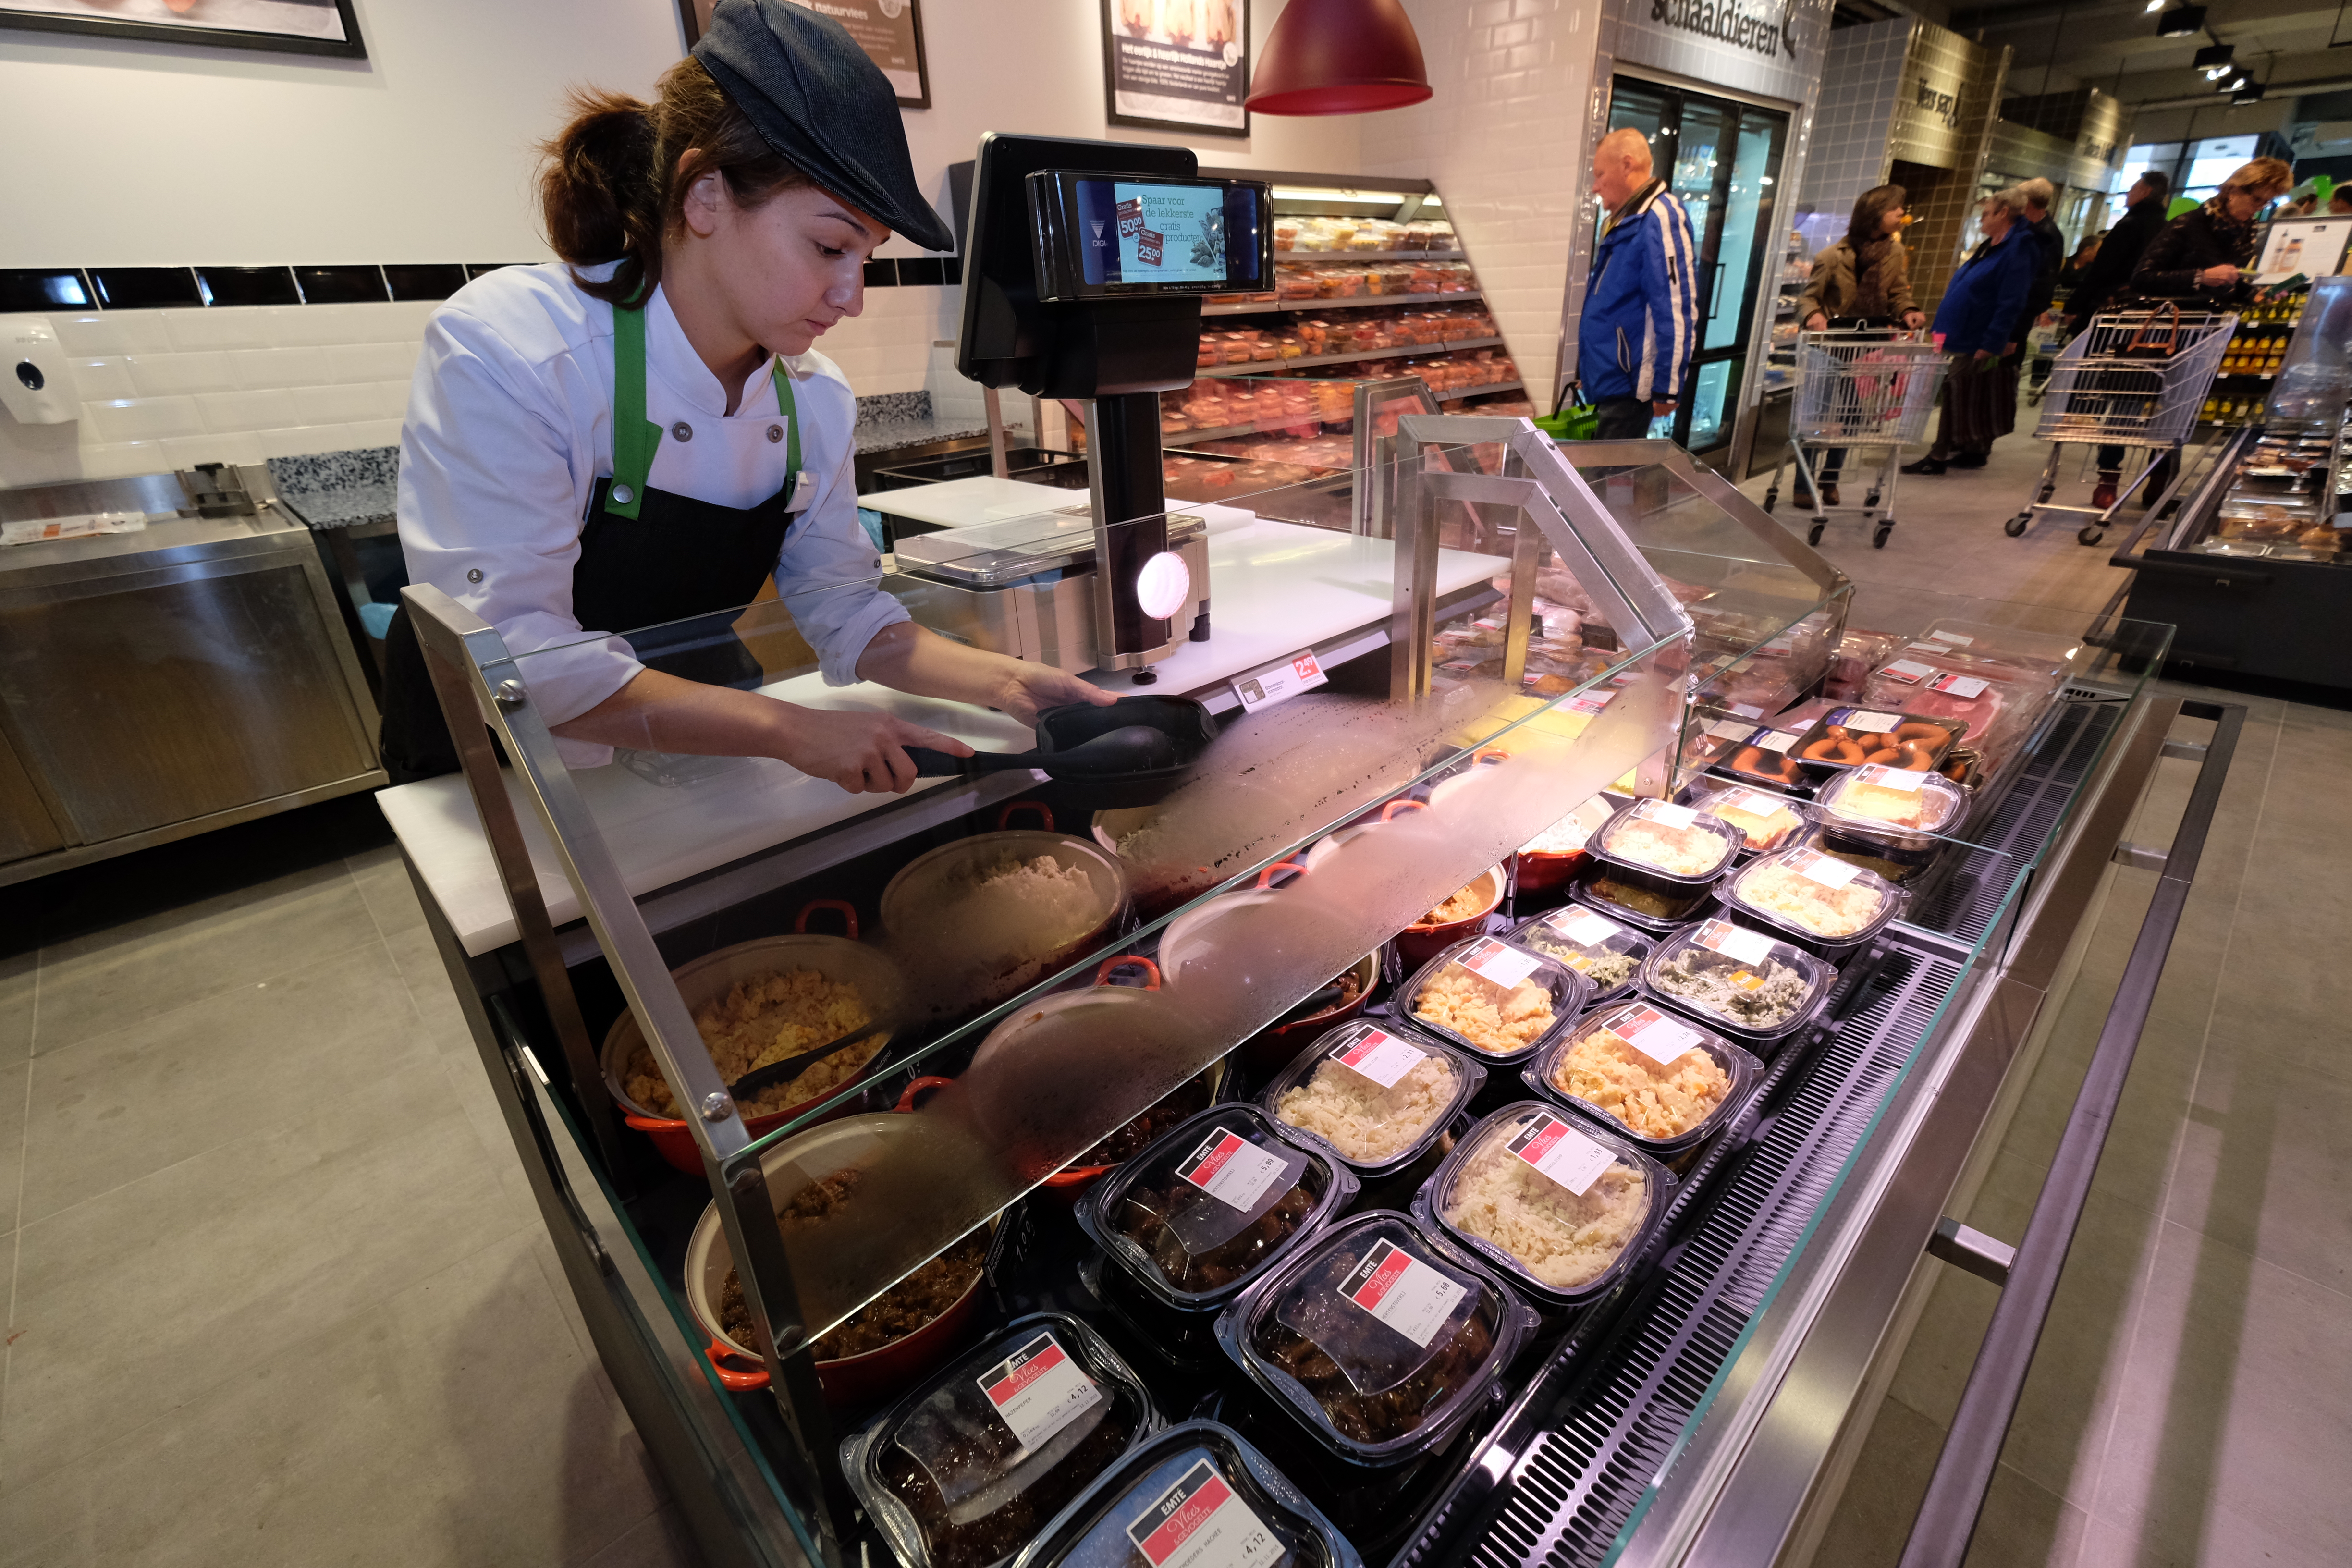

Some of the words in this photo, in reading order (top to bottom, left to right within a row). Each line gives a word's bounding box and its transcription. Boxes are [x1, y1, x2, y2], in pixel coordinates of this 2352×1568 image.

[1117, 203, 1132, 211] Gratis
[1142, 195, 1165, 207] Spaar
[1145, 208, 1156, 218] de
[1158, 208, 1194, 218] lekkerste
[1141, 230, 1155, 238] Gratis
[1160, 221, 1180, 233] gratis
[1524, 1127, 1539, 1140] EMTÉ
[1531, 1134, 1551, 1149] Vlees
[1196, 1145, 1213, 1161] EMTÉ
[1203, 1151, 1225, 1169] Vlees
[1590, 1148, 1602, 1158] 1,93
[1261, 1158, 1274, 1170] 5,09
[1360, 1260, 1378, 1278] EMTÉ
[1369, 1269, 1391, 1289] Vlees
[1435, 1282, 1449, 1296] 5,60
[1010, 1363, 1038, 1384] Vlees
[1071, 1385, 1088, 1399] 4,12
[1005, 1397, 1031, 1417] HAZENPEPER
[1161, 1487, 1187, 1516] EMTÉ
[1167, 1504, 1200, 1533] Vlees
[1203, 1528, 1221, 1547] HACHEE
[1246, 1532, 1265, 1553] 4,12
